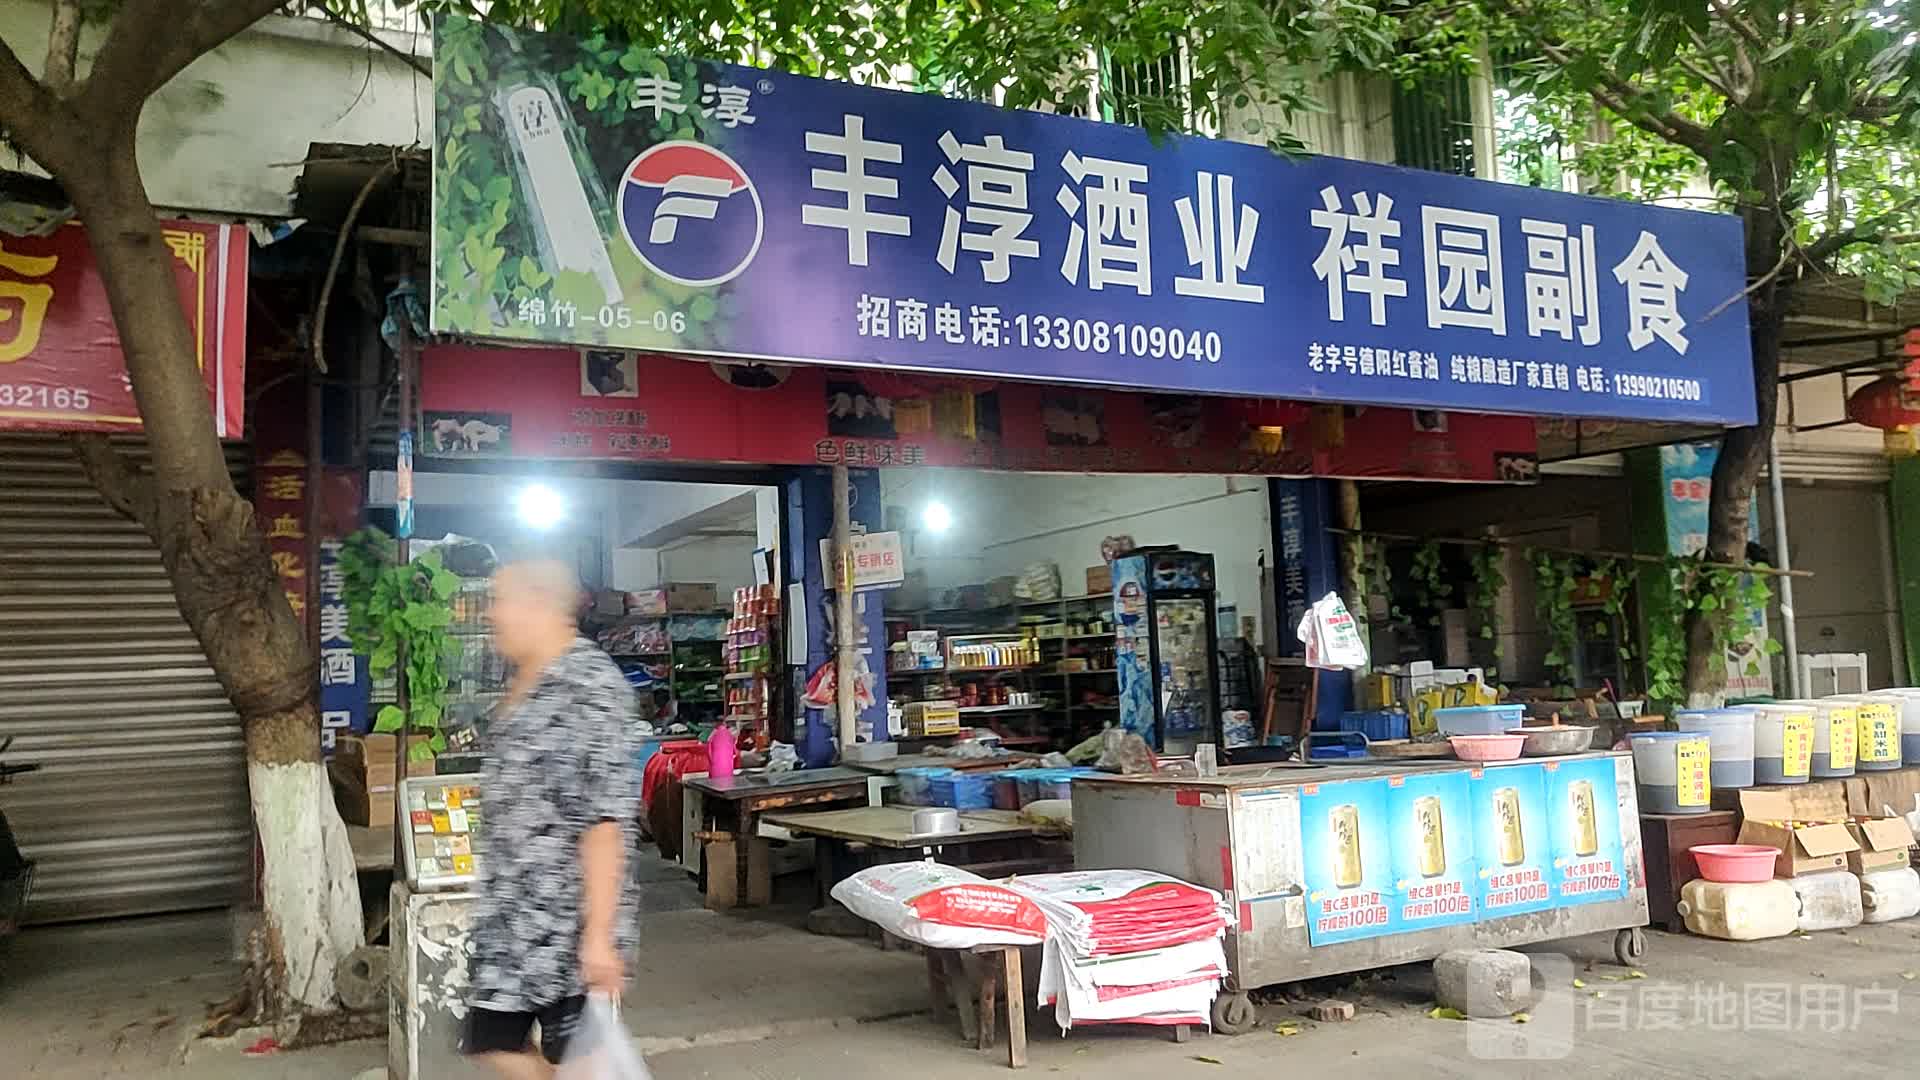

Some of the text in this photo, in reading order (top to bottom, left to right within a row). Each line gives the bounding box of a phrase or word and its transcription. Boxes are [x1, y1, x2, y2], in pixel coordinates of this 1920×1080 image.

[631, 74, 756, 128] 丰淳
[801, 114, 1690, 355] 丰淳酒业 祥园副食
[518, 297, 686, 333] 绵竹-05-06
[856, 294, 1222, 363] 招商电话:13308109040
[1308, 342, 1440, 380] 老字号德阳红酱油
[1451, 355, 1570, 391] 纯粮酿造厂家直销
[816, 440, 924, 465] 色鲜味美
